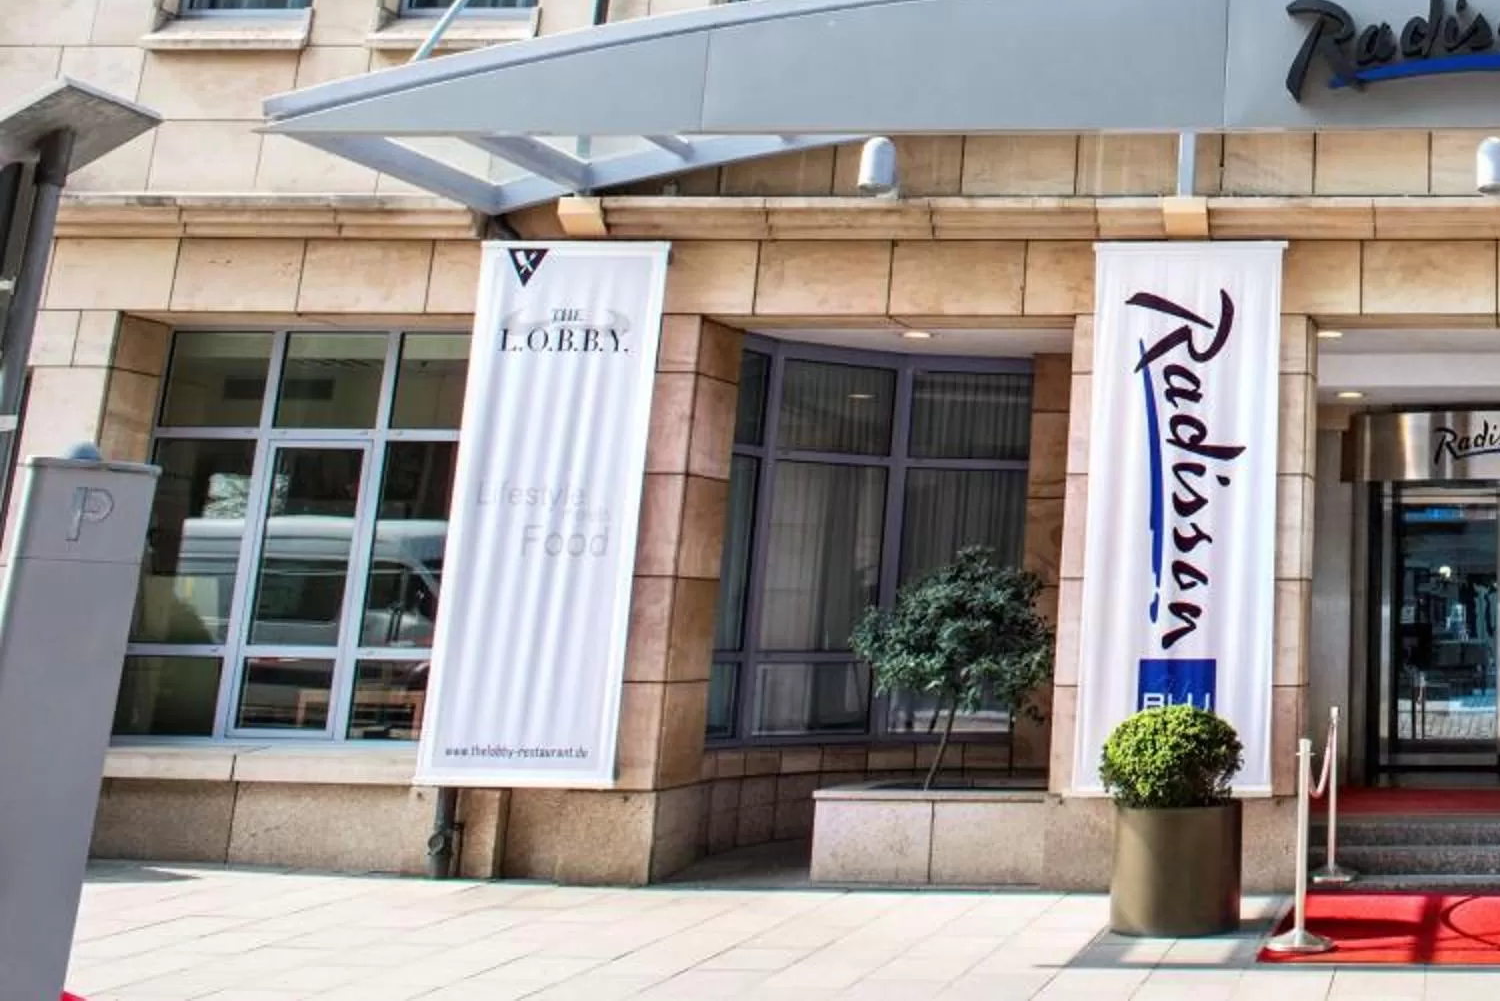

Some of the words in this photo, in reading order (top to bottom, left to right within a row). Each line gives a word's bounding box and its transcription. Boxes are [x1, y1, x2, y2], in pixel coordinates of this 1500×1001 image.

[551, 308, 584, 322] THE
[1125, 288, 1247, 649] Radisson
[66, 486, 115, 541] P
[522, 524, 609, 556] Food
